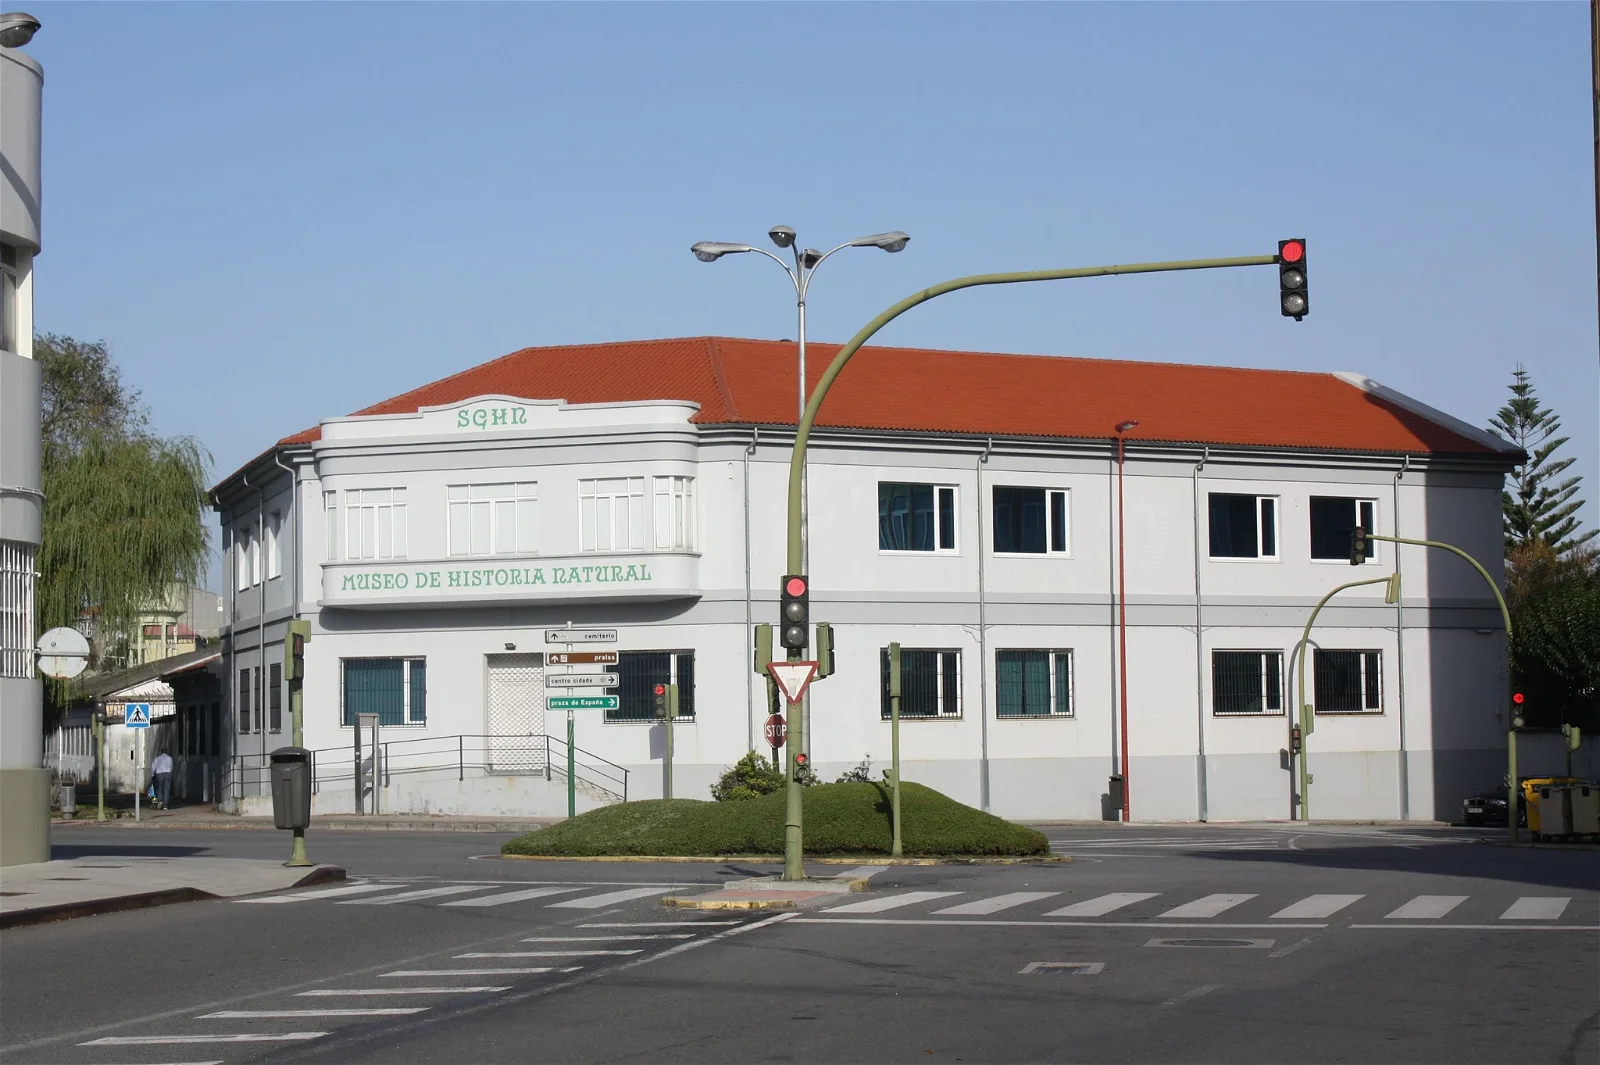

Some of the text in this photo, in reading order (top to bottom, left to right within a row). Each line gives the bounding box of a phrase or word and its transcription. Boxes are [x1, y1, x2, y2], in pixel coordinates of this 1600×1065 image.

[457, 407, 527, 429] SGHN
[341, 564, 652, 590] MUSEO DE HISTORIA NATURAL
[766, 724, 787, 737] STOP
